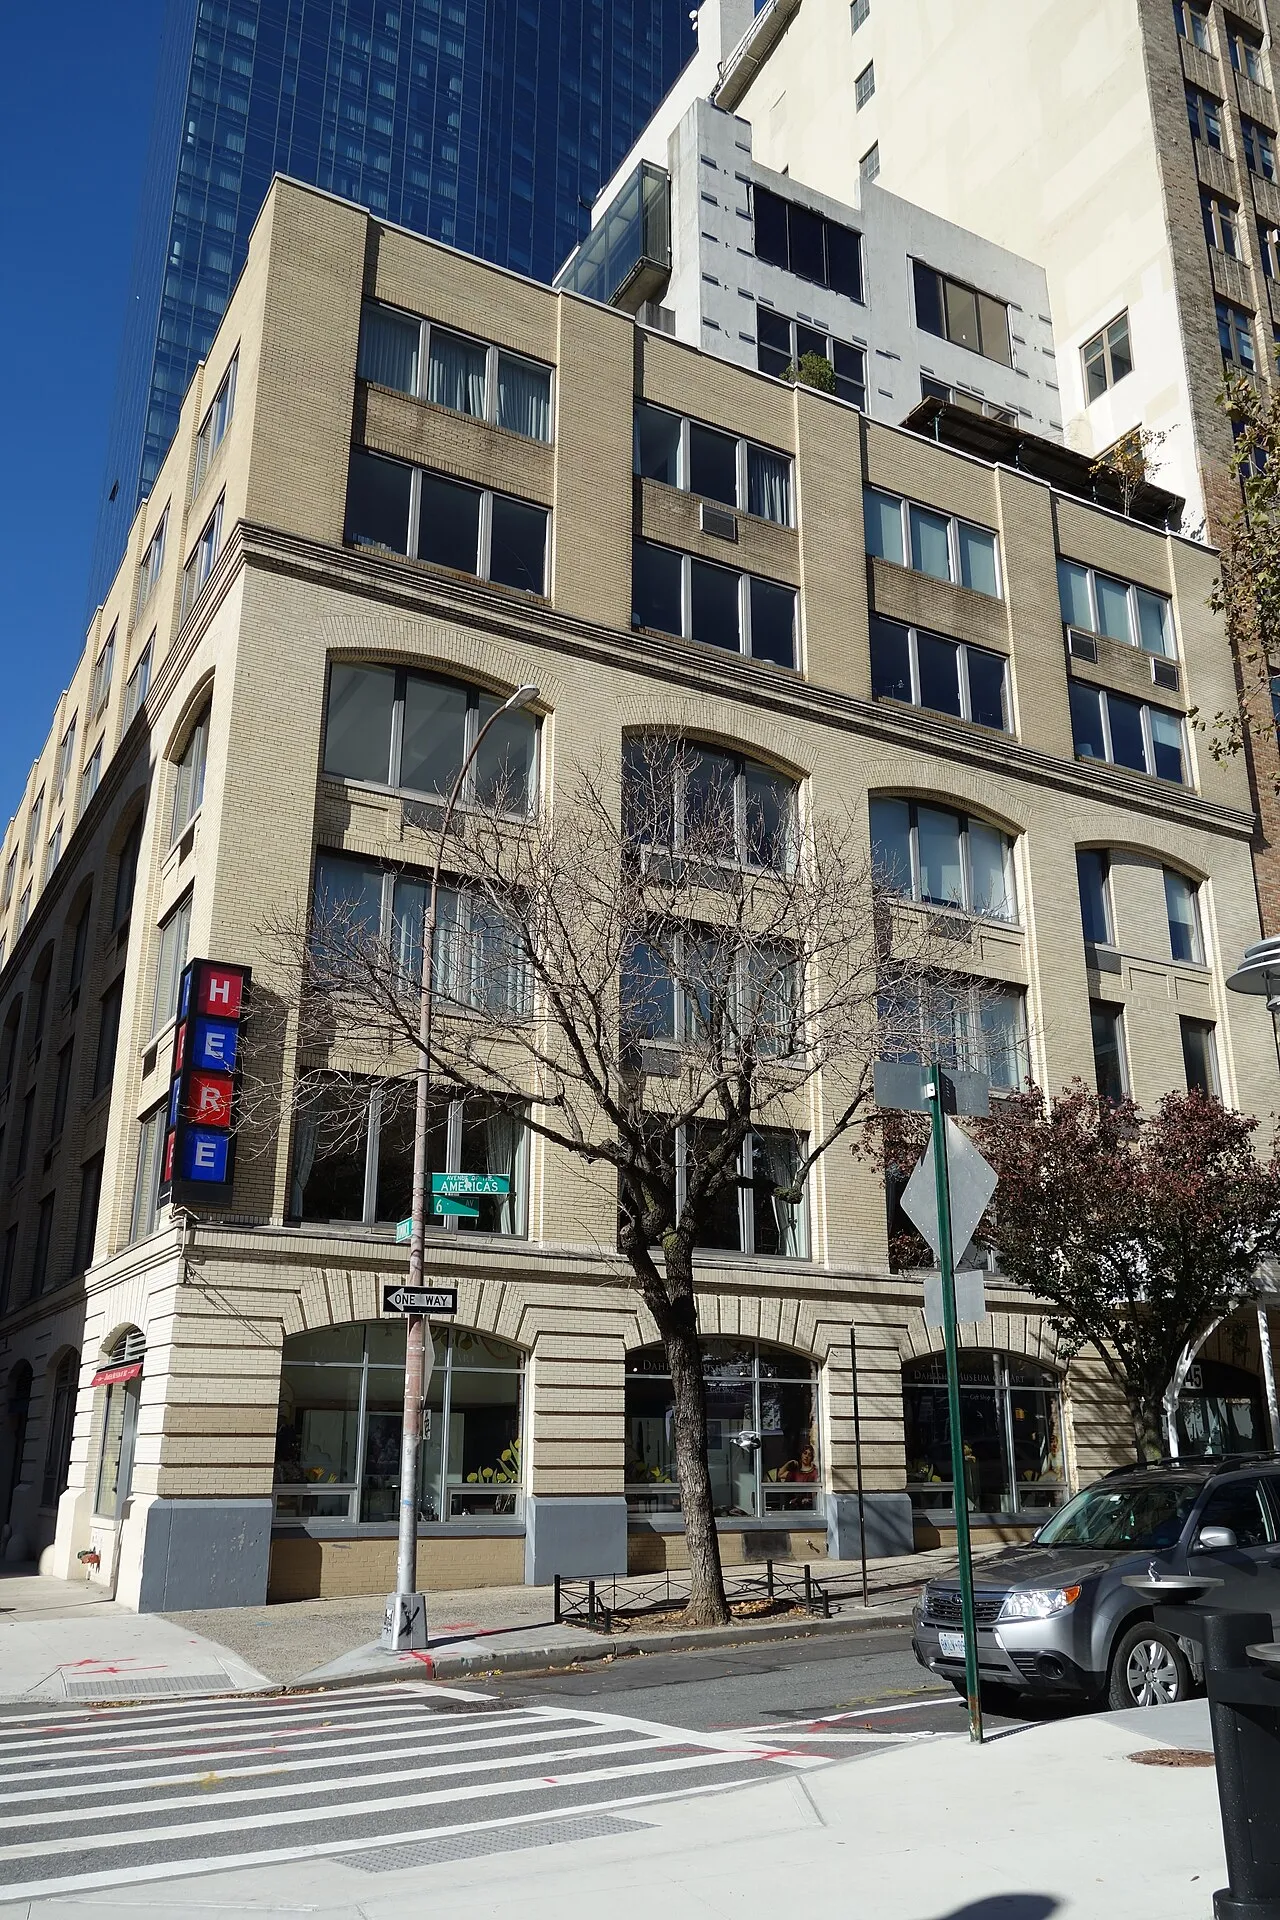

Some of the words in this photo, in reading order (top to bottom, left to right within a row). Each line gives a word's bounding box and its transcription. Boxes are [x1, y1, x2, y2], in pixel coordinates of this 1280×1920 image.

[195, 979, 229, 1168] HERE
[440, 1181, 498, 1192] AMERICAS
[435, 1198, 443, 1213] 6
[465, 1199, 474, 1207] AV
[394, 1293, 416, 1305] ONE
[425, 1295, 448, 1306] WAY
[1010, 1374, 1025, 1383] ART
